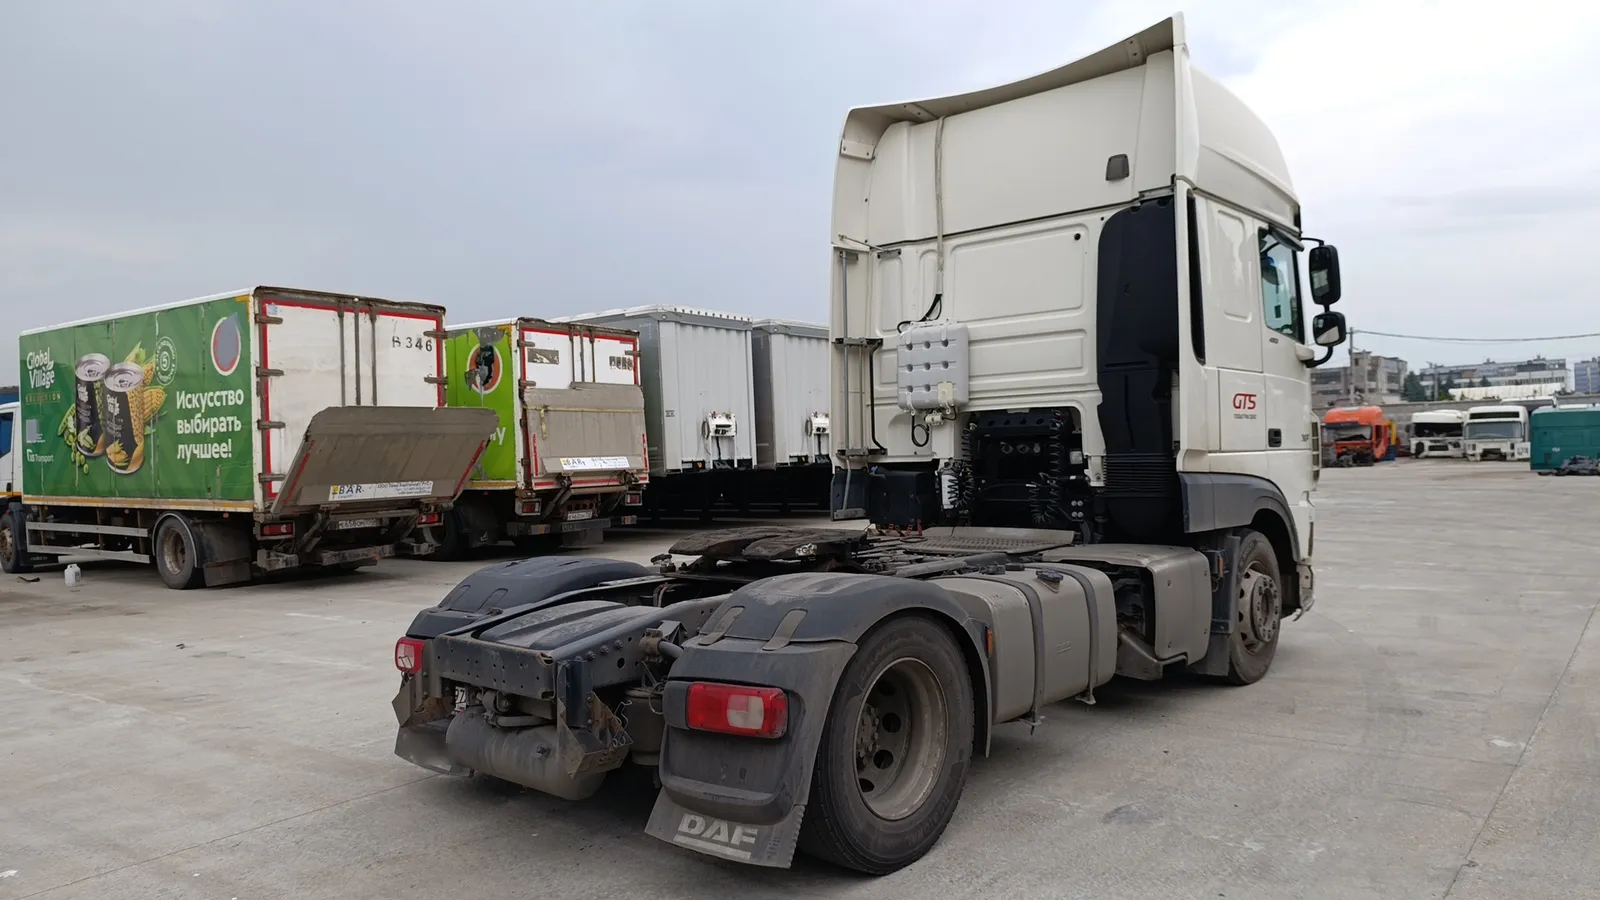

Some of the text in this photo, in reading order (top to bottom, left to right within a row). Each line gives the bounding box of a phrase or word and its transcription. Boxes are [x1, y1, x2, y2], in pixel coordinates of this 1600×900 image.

[406, 337, 433, 352] 346
[26, 346, 50, 370] Global
[29, 369, 55, 389] Village
[176, 389, 244, 413] Искусство
[1233, 393, 1257, 409] GTS
[177, 412, 242, 438] выбирать
[177, 438, 232, 464] лучшее!
[677, 813, 759, 846] DAF
